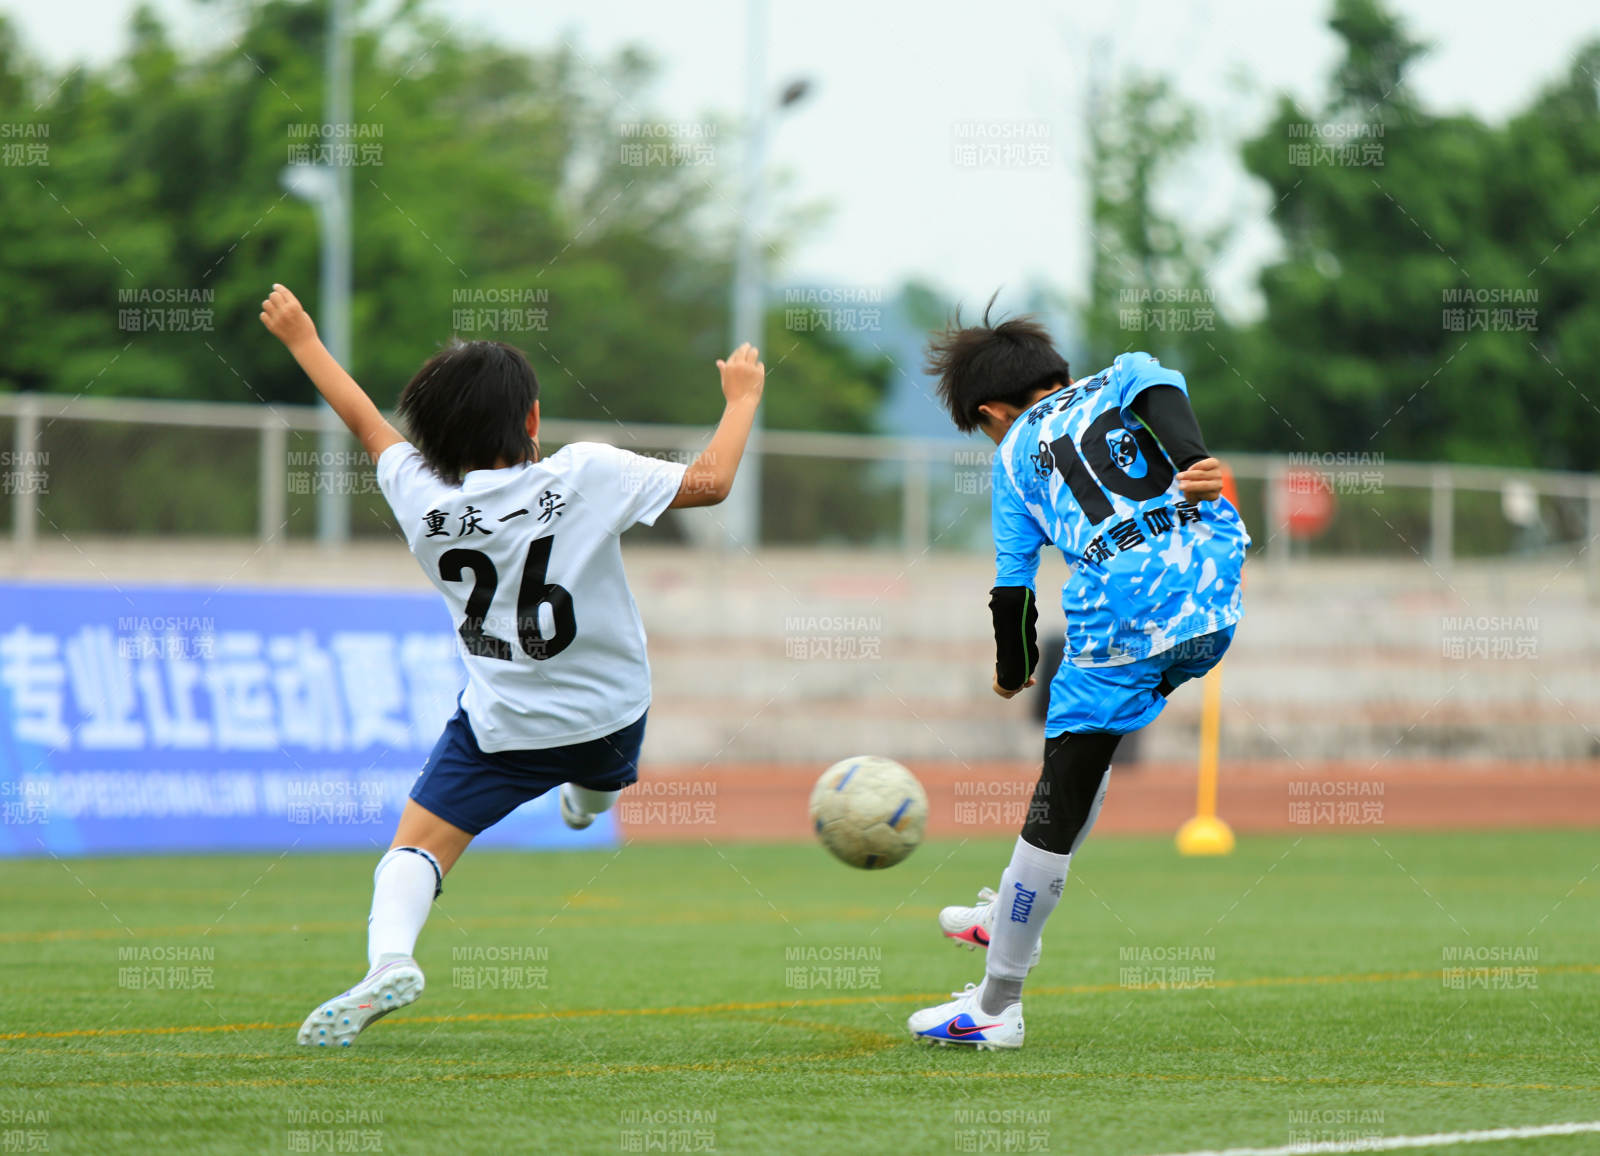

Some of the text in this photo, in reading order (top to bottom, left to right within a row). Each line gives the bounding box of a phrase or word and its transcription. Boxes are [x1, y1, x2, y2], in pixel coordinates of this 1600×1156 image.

[1050, 406, 1174, 526] 10
[422, 491, 566, 537] 重庆一实
[438, 535, 577, 661] 26
[1011, 882, 1036, 923] Joma
